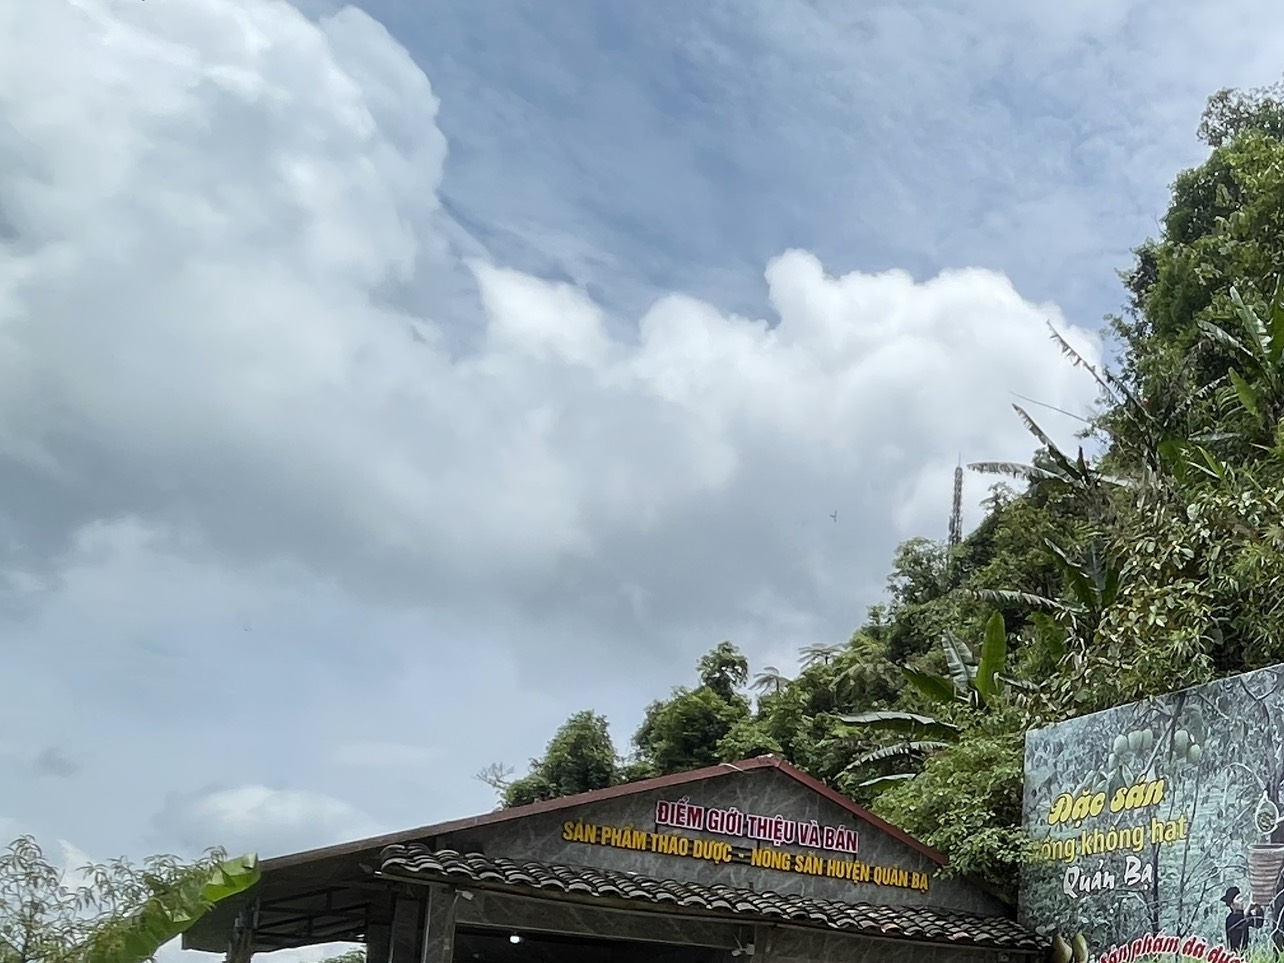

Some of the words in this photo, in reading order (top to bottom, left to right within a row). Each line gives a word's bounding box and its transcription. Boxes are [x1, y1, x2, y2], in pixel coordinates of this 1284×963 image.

[656, 795, 704, 831] ĐIỂM
[706, 806, 744, 837] GIỚI
[747, 813, 796, 847] THIỆU
[798, 818, 822, 848] VÀ
[824, 824, 859, 853] BÁN
[1049, 788, 1106, 828] Đặc
[562, 818, 597, 844] SẢN
[600, 823, 647, 851] PHẨM
[650, 829, 688, 857] THẢO
[692, 838, 733, 864] DƯỢC
[751, 848, 791, 871] NÔNG
[826, 858, 870, 885] HUYỆN
[873, 862, 908, 888] QUẢN
[911, 871, 929, 893] BẠ
[1031, 835, 1076, 863] ồng
[1082, 825, 1144, 855] không
[1151, 814, 1187, 847] hạt
[1124, 855, 1153, 890] Bạ
